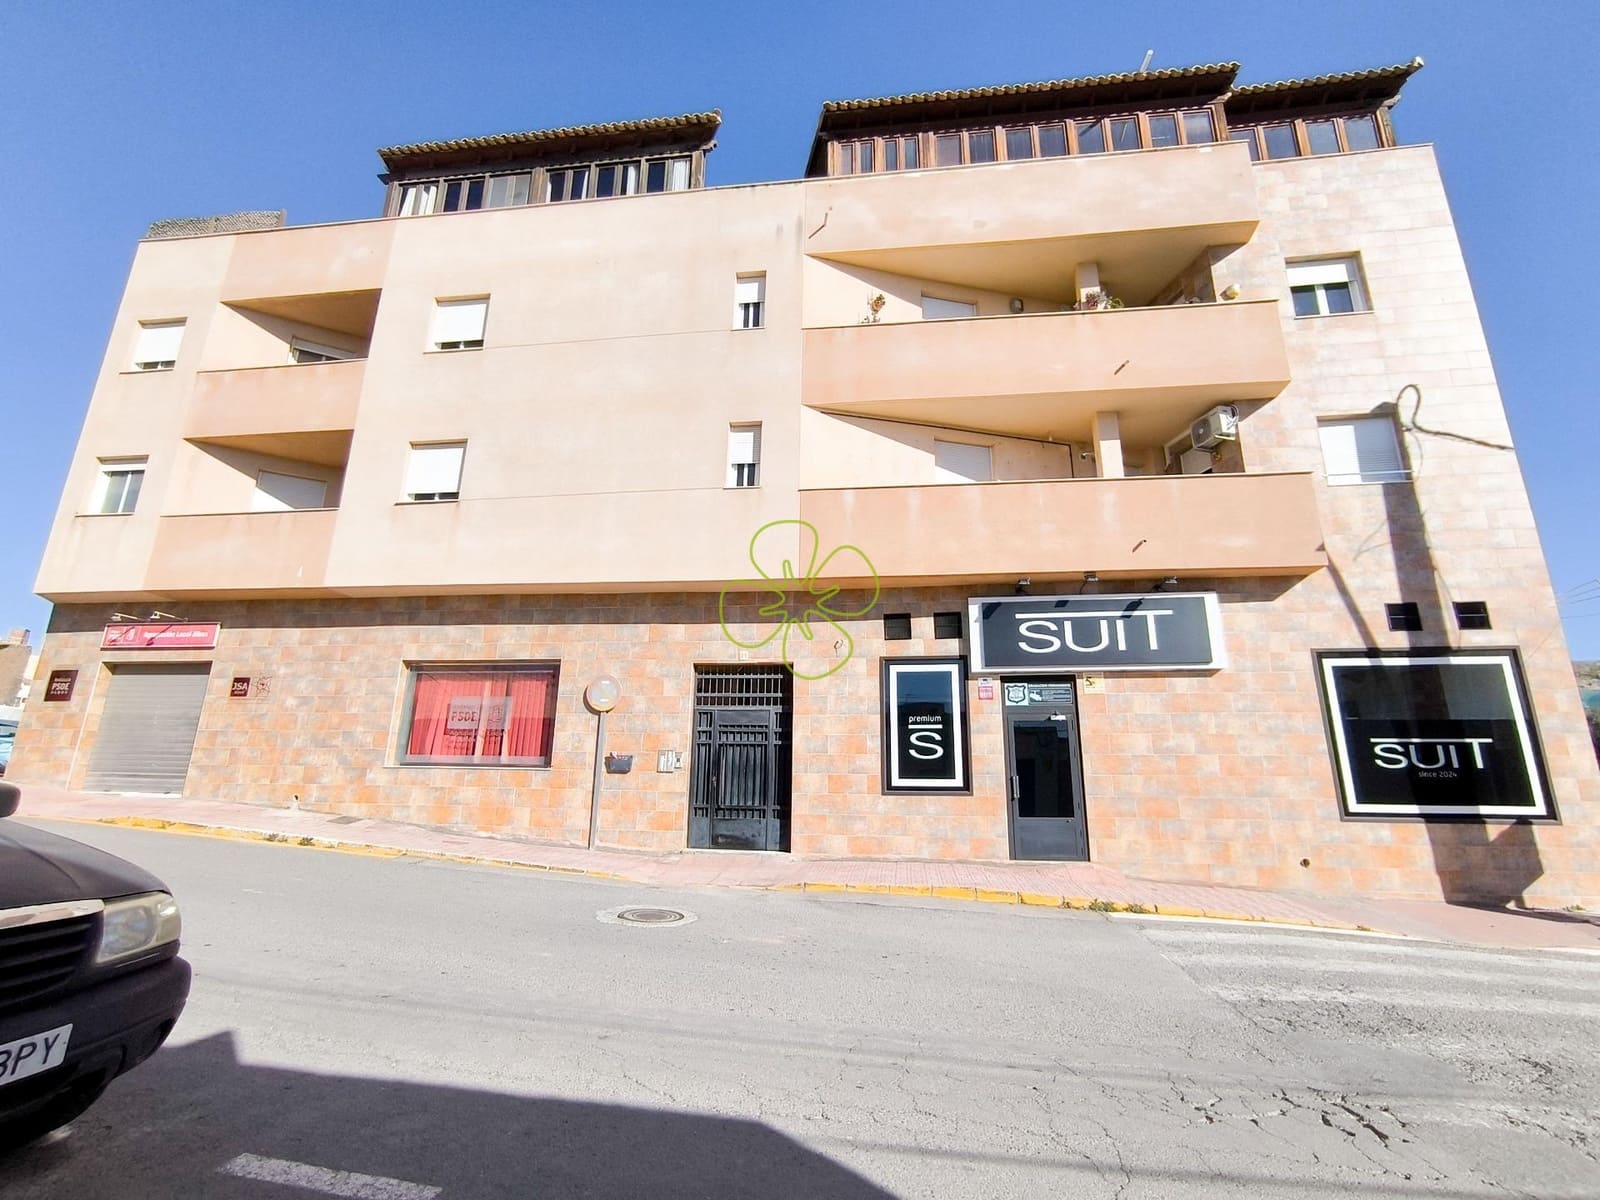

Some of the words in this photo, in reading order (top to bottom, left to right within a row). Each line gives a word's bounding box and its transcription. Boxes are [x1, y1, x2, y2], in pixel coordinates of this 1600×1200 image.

[1015, 609, 1174, 654] SUIT
[51, 682, 71, 690] PSOE
[908, 714, 942, 723] premium
[908, 731, 944, 760] S
[1369, 738, 1493, 769] SUIT
[1418, 770, 1437, 778] since
